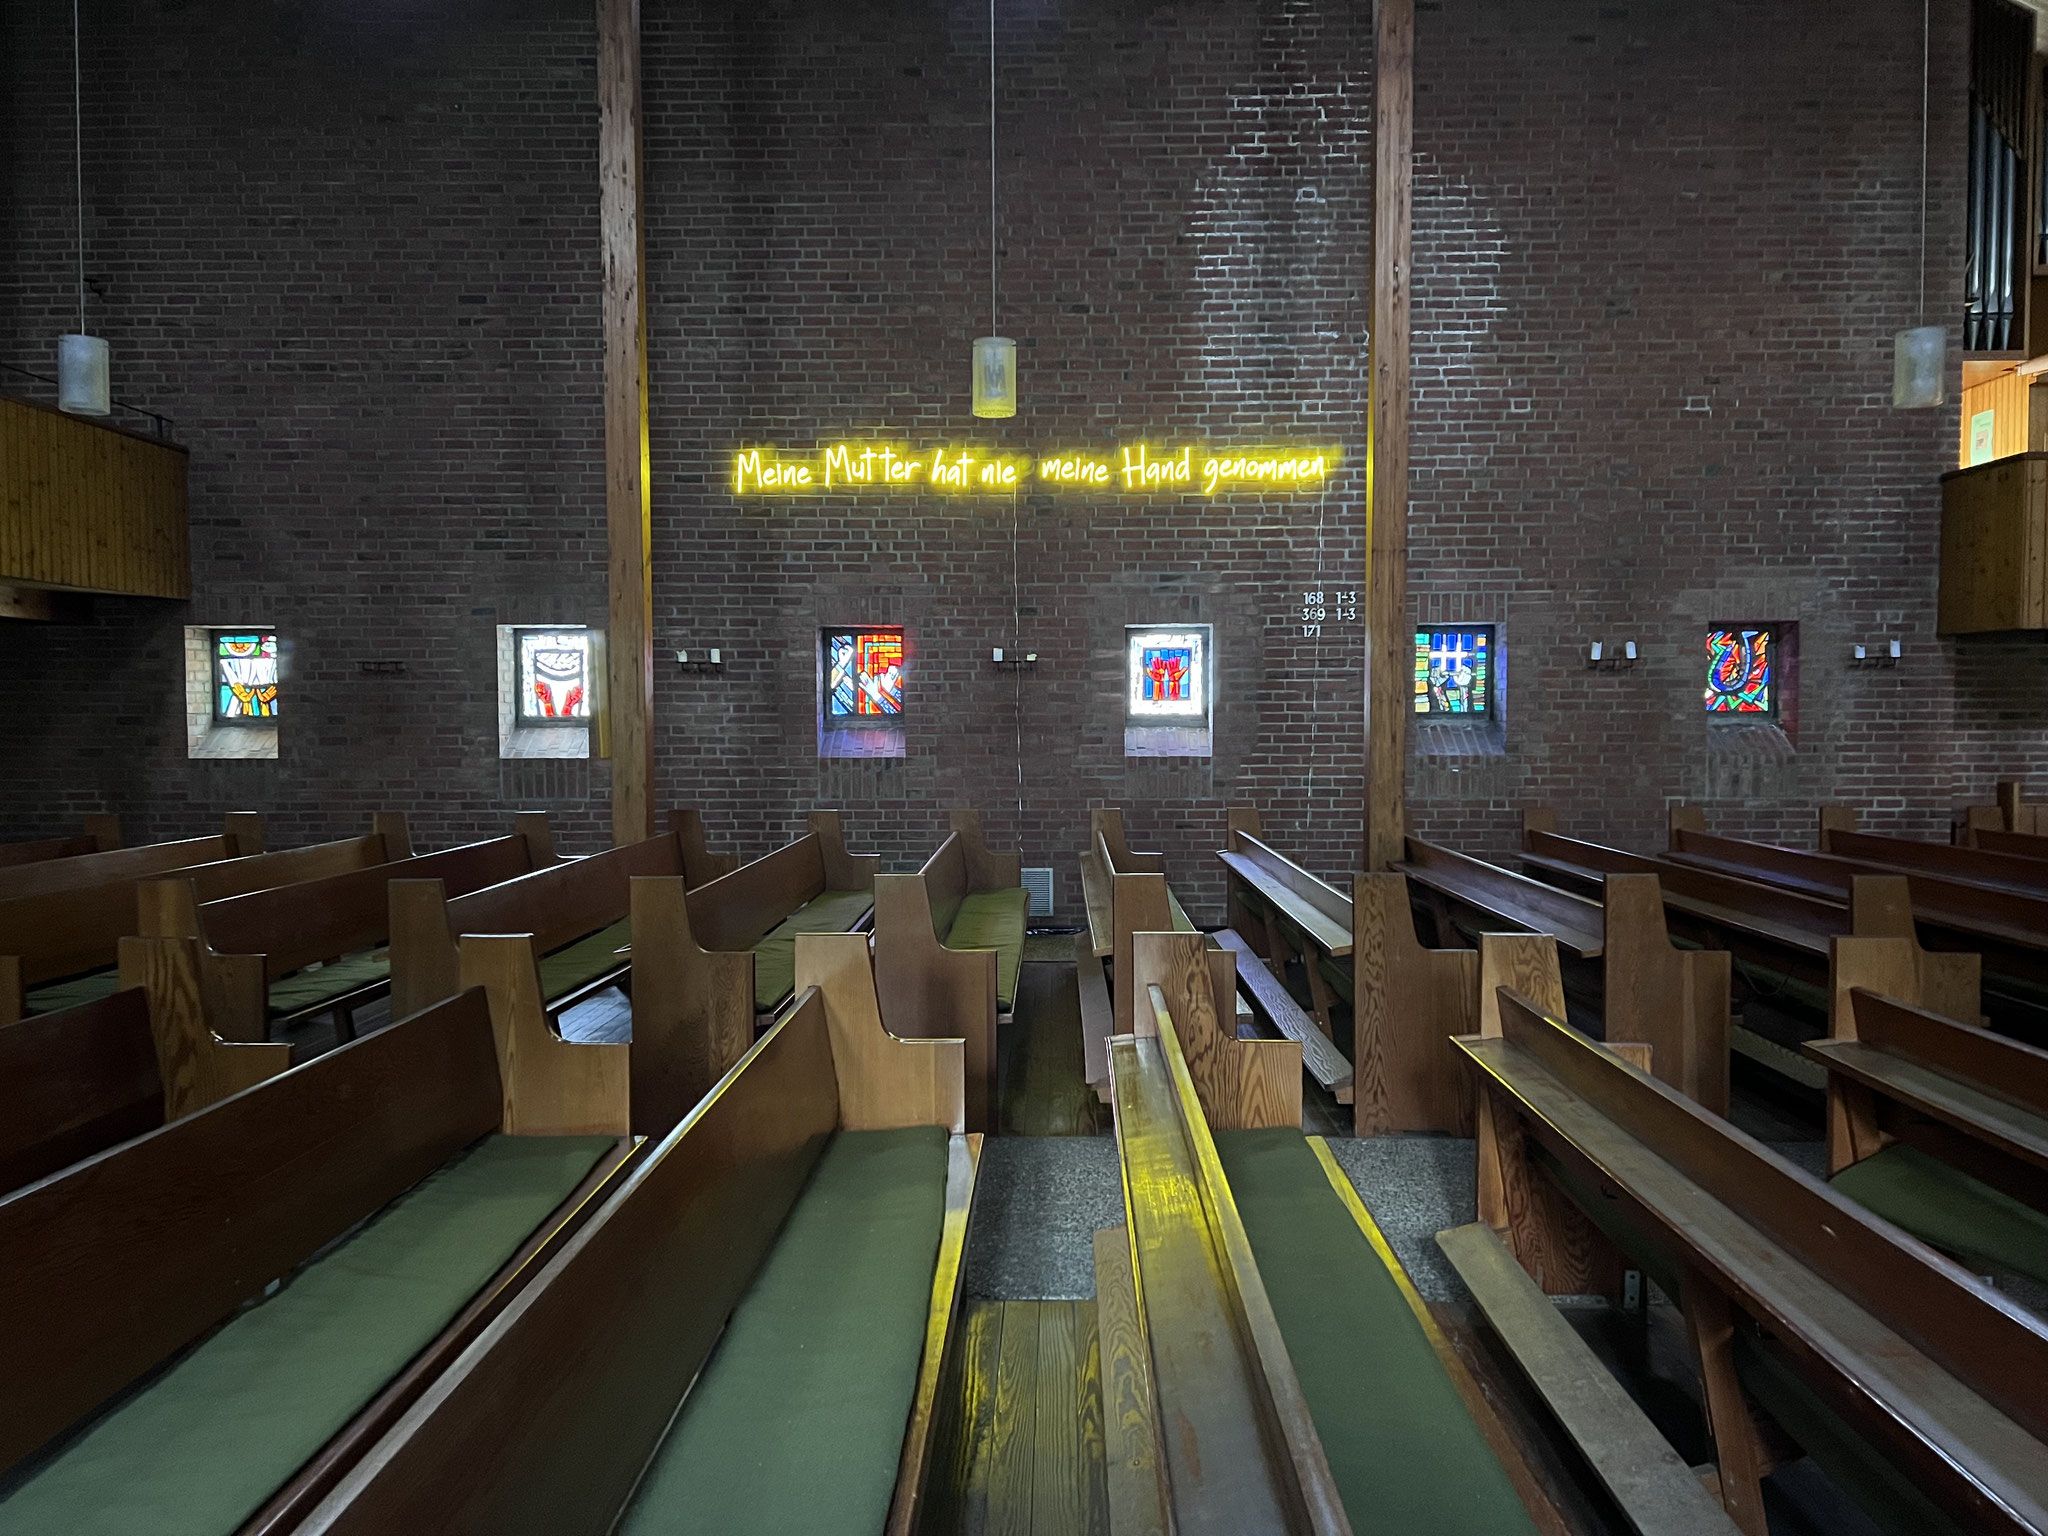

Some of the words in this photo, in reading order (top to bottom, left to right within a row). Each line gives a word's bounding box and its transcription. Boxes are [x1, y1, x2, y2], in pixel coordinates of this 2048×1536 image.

[737, 450, 812, 493] Meine
[824, 445, 921, 488] Mutter
[931, 448, 975, 487] hat
[981, 460, 1017, 485] nie
[1041, 457, 1109, 483] meine
[1121, 444, 1191, 488] Hand
[1203, 455, 1325, 494] genommen
[1303, 591, 1325, 605] 168
[1335, 591, 1357, 605] 1-3
[1301, 607, 1326, 621] 369
[1336, 607, 1356, 621] 1-3
[1302, 624, 1321, 638] 171
